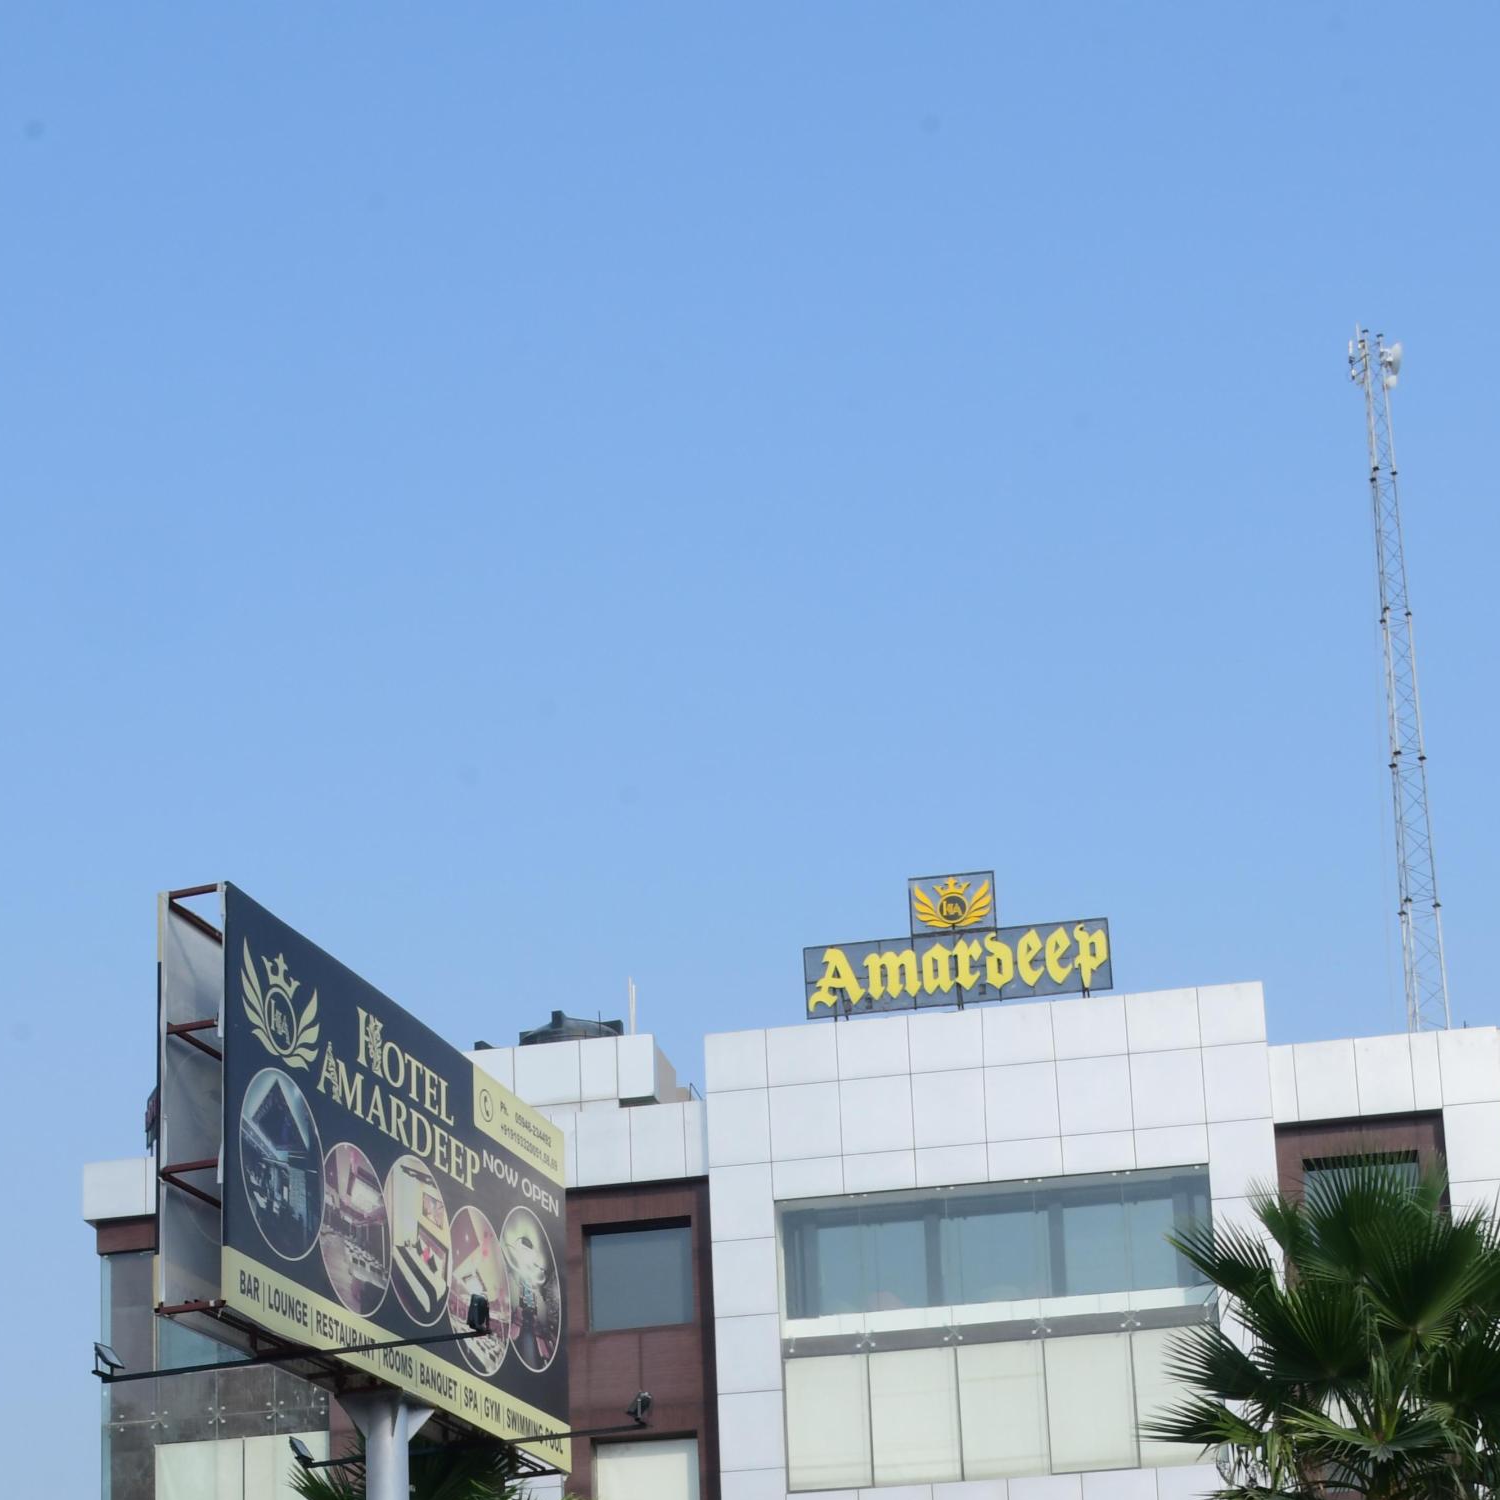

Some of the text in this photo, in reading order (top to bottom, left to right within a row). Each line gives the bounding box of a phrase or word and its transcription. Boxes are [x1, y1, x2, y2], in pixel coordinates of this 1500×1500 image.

[808, 923, 1108, 1013] Amardeep
[316, 1041, 480, 1191] AMARDEEP
[357, 1006, 454, 1127] HOTEL
[483, 1149, 559, 1217] NOW OPEN
[240, 1270, 259, 1303] BAR
[268, 1284, 308, 1327] LOUNGE
[315, 1310, 376, 1361] RESTAURANT
[382, 1346, 413, 1379] ROOMS
[419, 1363, 458, 1400] BANQUET
[463, 1386, 478, 1413] SPA
[484, 1396, 501, 1425] GYM
[507, 1408, 544, 1444] SWIMMING
